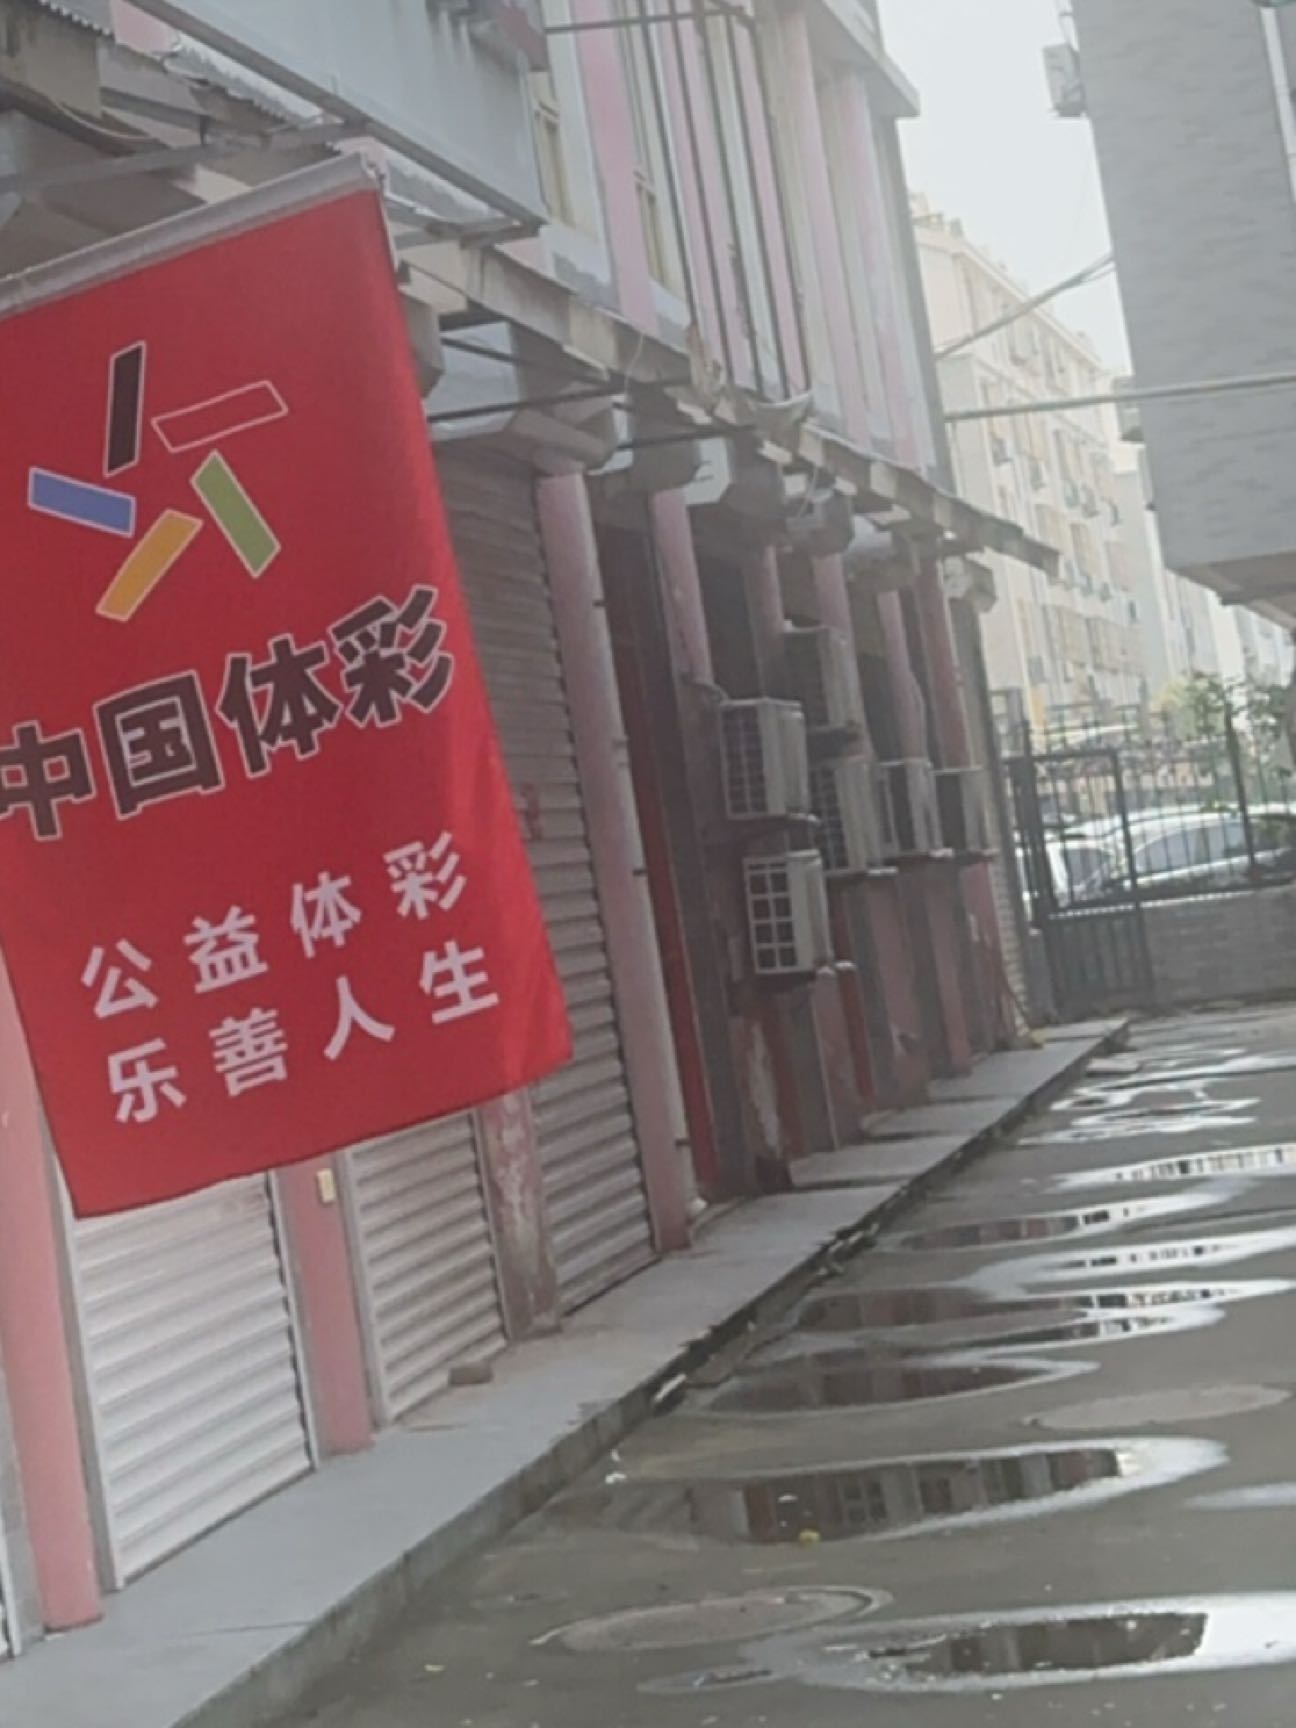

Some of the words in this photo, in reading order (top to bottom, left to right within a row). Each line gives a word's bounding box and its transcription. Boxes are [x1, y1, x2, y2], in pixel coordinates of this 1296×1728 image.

[80, 828, 469, 1021] 公益体彩
[105, 938, 501, 1125] 乐善人生
